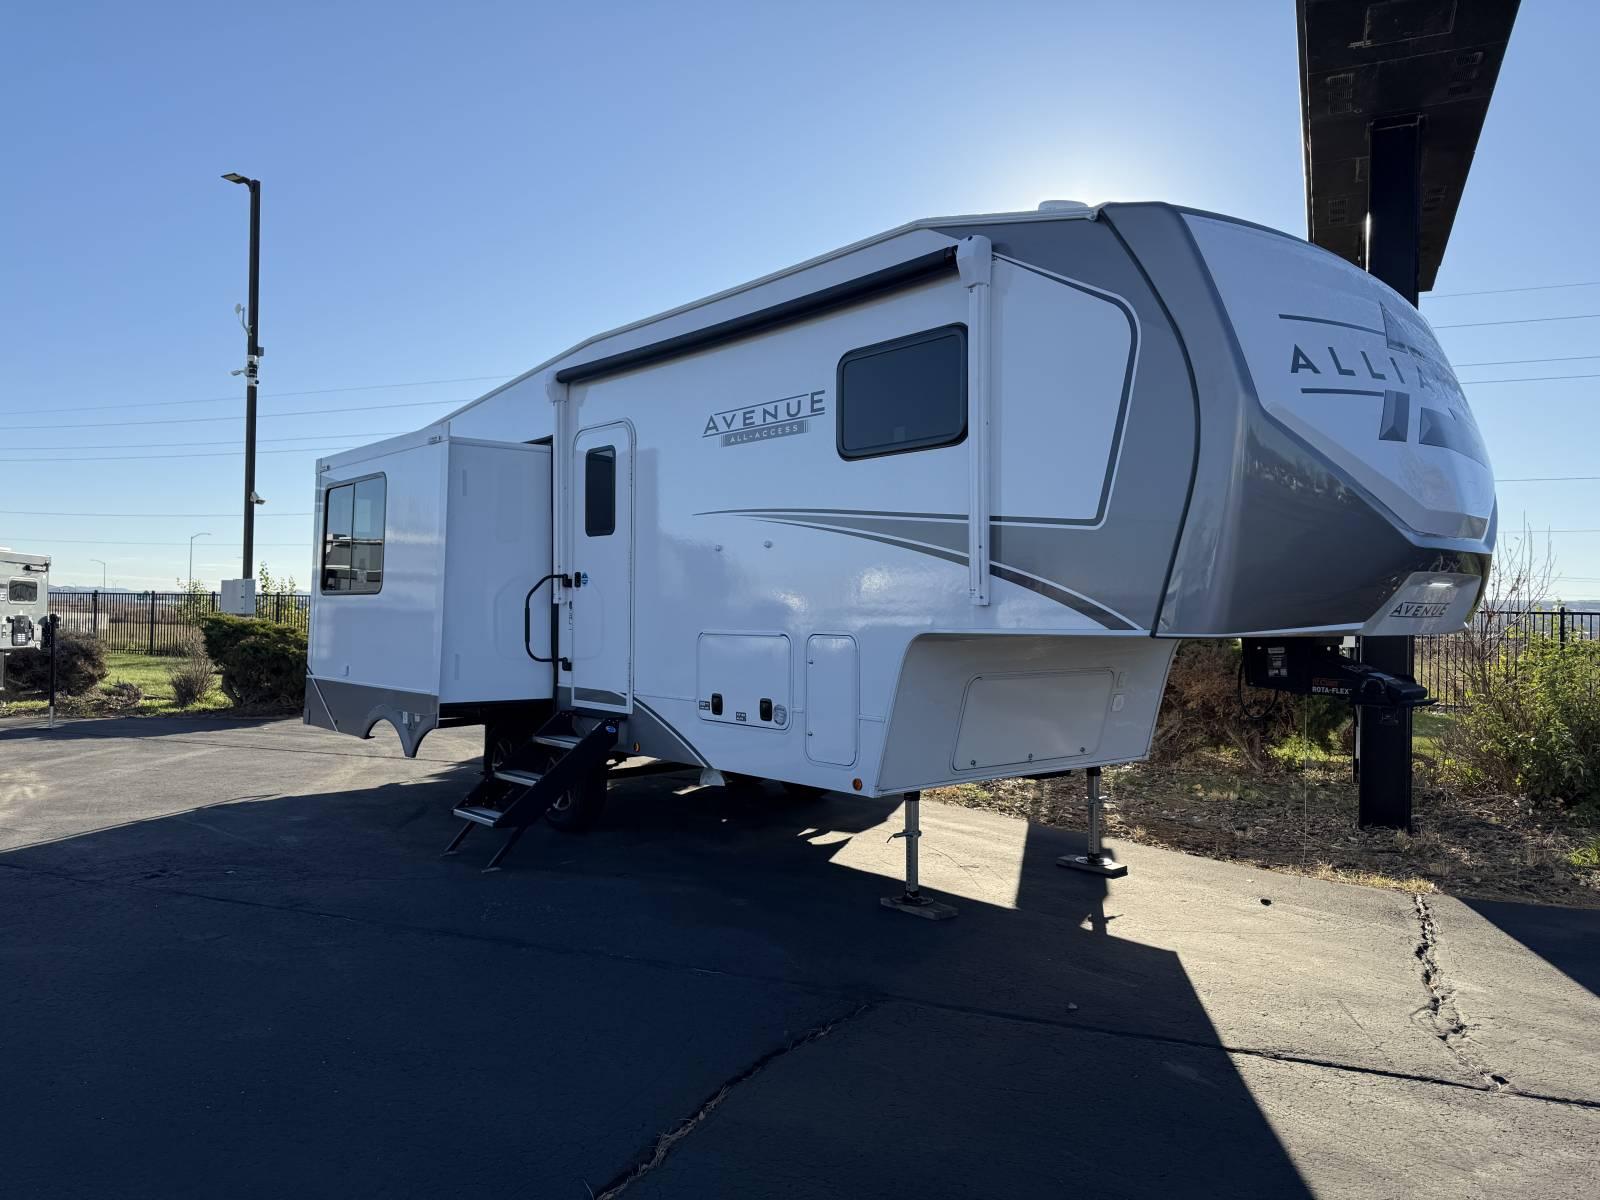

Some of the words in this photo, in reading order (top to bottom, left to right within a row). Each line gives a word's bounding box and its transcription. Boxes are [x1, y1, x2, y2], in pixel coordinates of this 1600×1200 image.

[703, 389, 826, 435] AVENUE
[729, 424, 799, 443] ALL-ACCESS
[1390, 602, 1450, 616] AVENUE
